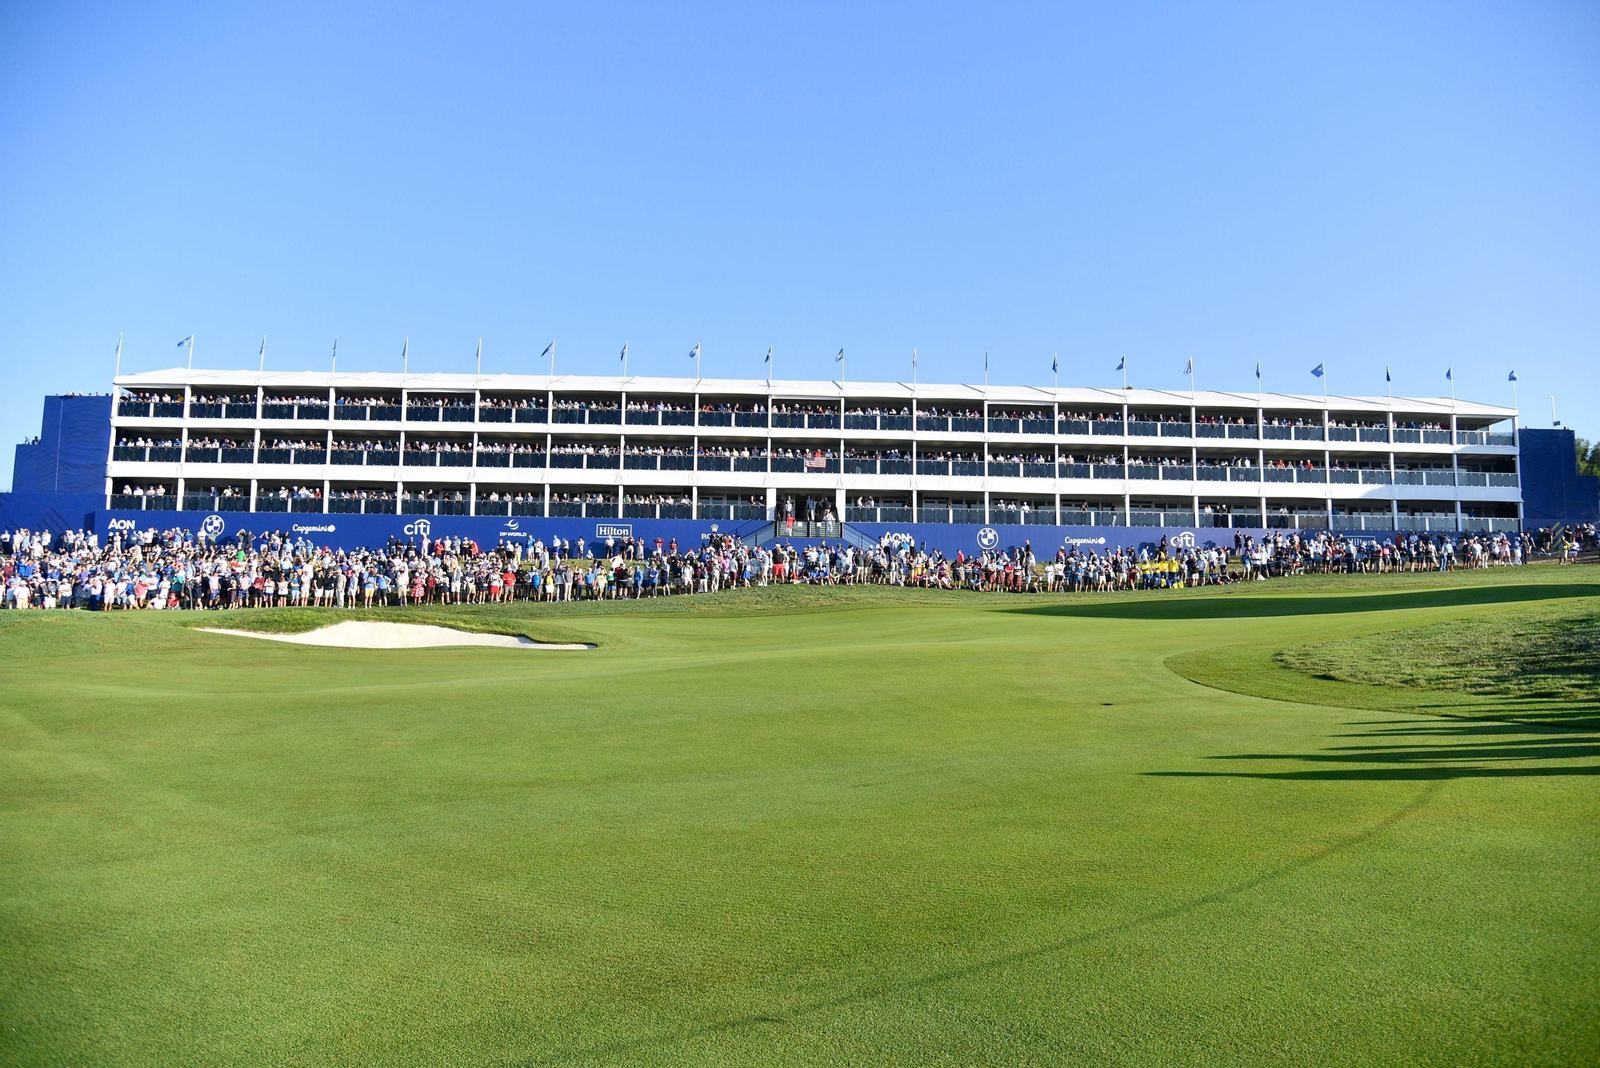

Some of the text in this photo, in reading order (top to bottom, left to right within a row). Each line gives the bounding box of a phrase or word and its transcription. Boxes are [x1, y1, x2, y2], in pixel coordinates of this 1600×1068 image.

[107, 518, 136, 530] AON
[292, 523, 328, 535] Capgemini
[403, 521, 431, 535] citi
[599, 526, 629, 536] Hilton
[883, 531, 911, 543] AON
[1064, 536, 1099, 547] Capgemini
